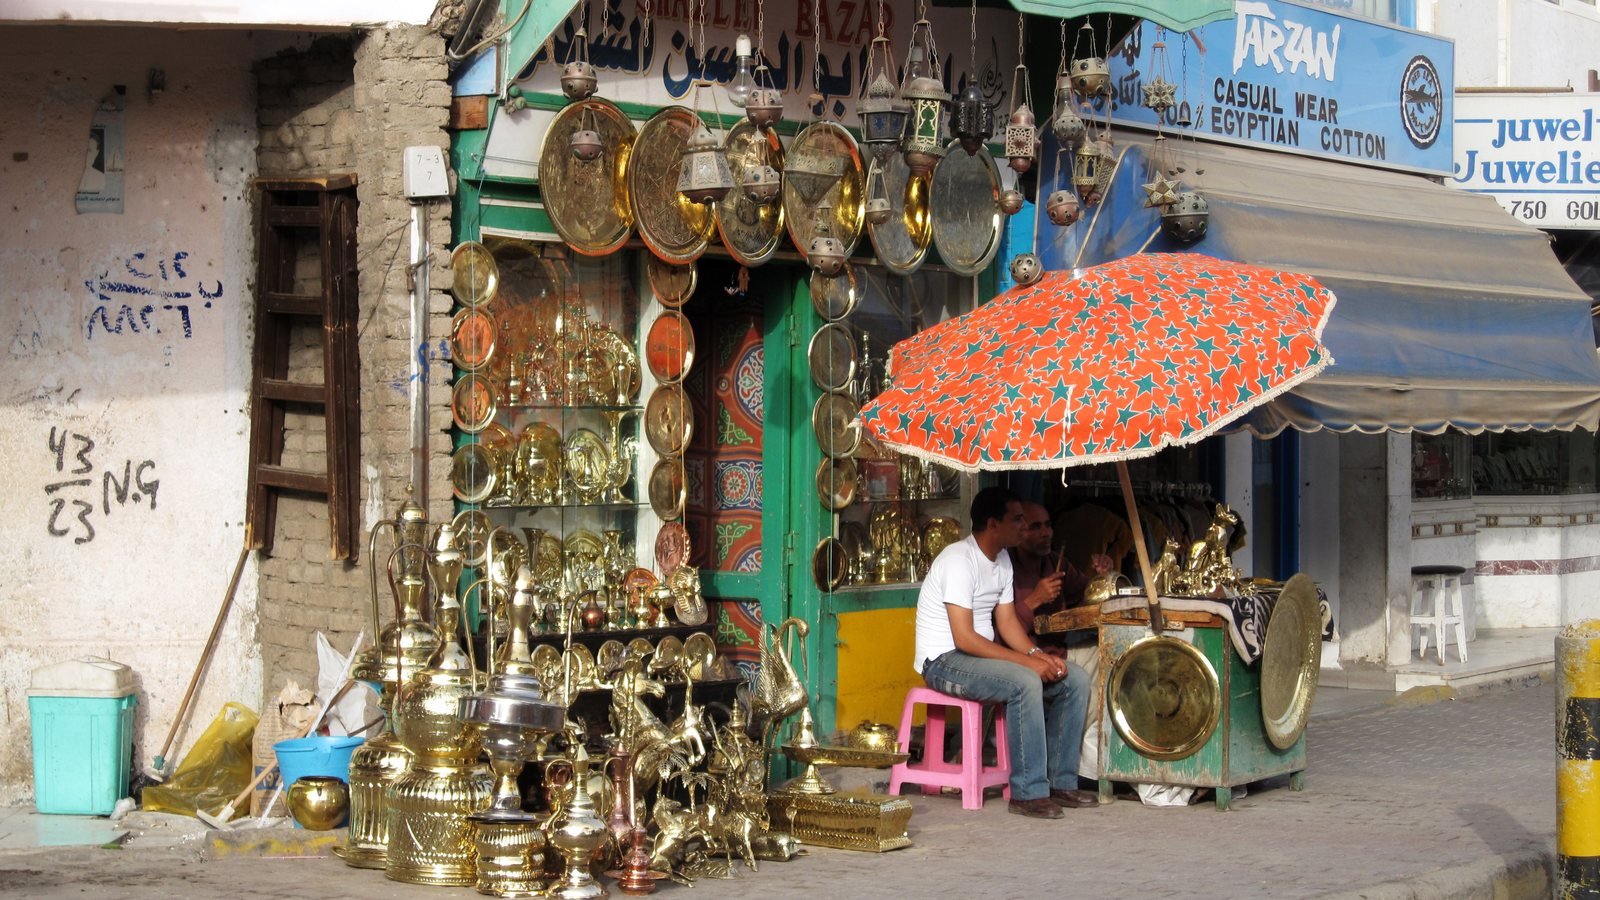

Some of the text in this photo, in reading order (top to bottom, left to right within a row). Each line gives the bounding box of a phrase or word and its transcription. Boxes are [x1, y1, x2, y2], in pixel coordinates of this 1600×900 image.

[1233, 0, 1341, 82] TARZAN
[1214, 77, 1338, 125] CASUAL WEAR
[1211, 106, 1299, 147] EGYPTIAN
[1320, 126, 1386, 160] COTTON
[1491, 108, 1593, 149] juwel
[1511, 200, 1547, 220] 750
[49, 426, 95, 474] 43
[48, 498, 96, 545] 23
